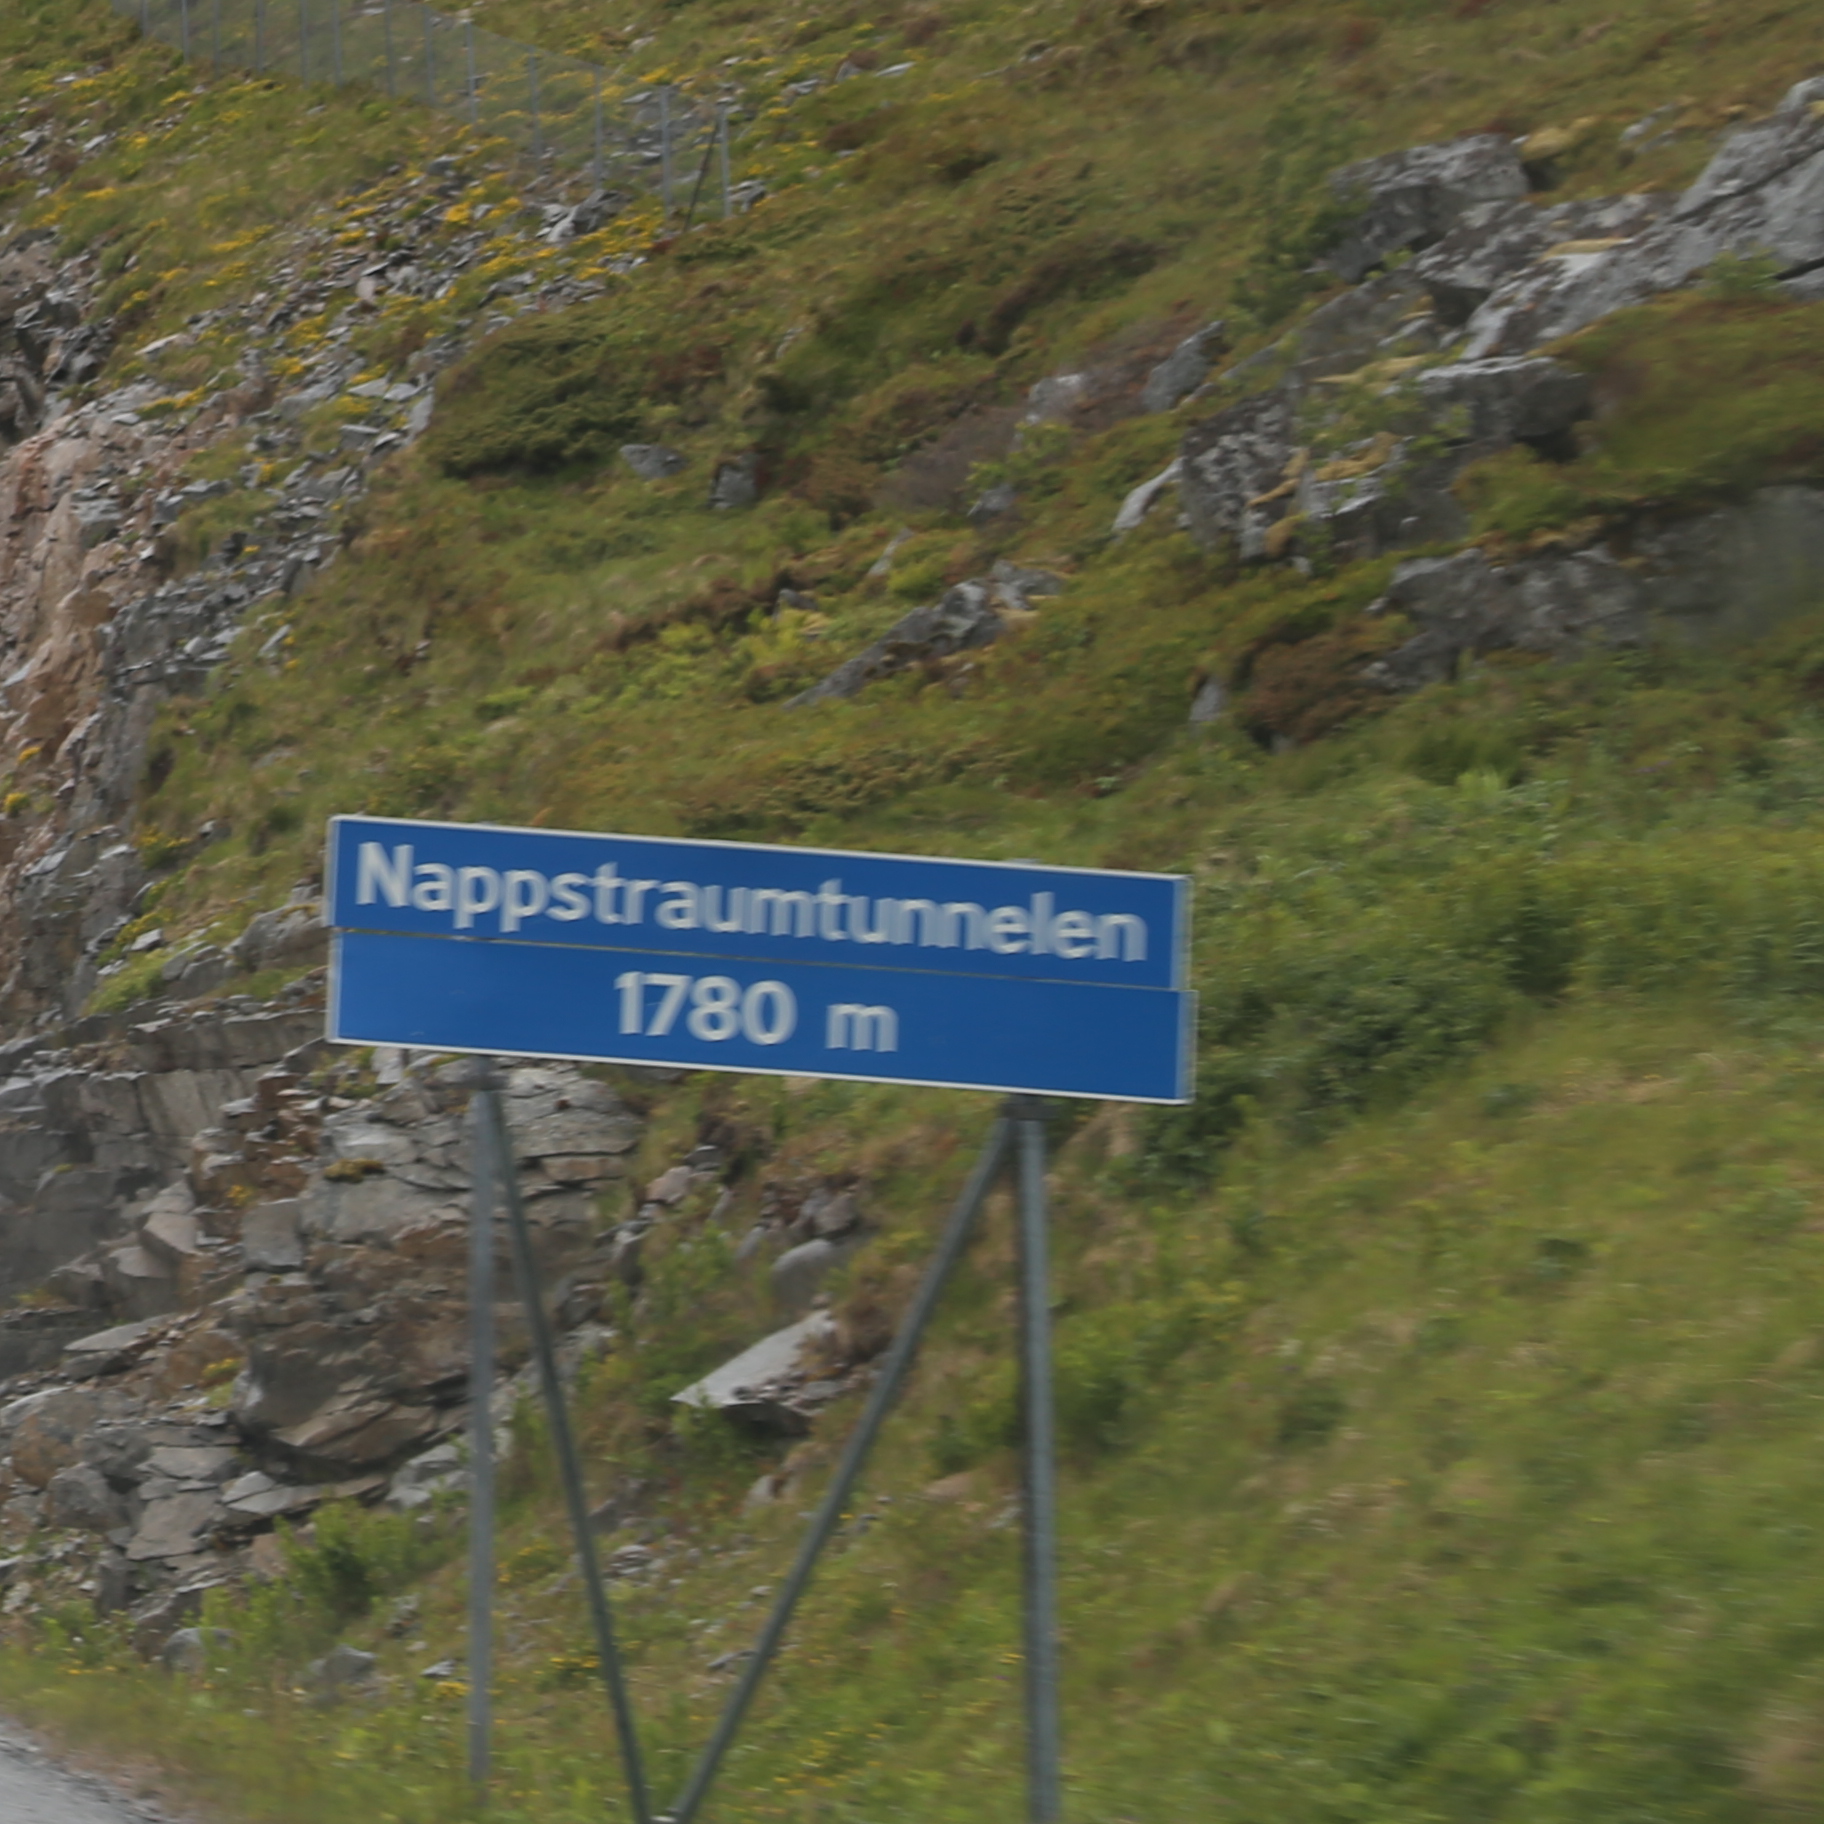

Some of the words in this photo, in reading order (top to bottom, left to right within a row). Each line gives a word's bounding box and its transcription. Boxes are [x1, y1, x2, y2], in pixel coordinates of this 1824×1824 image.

[356, 841, 1148, 963] Nappstraumtunnelen
[616, 971, 797, 1046] 1780
[826, 1002, 899, 1053] m
